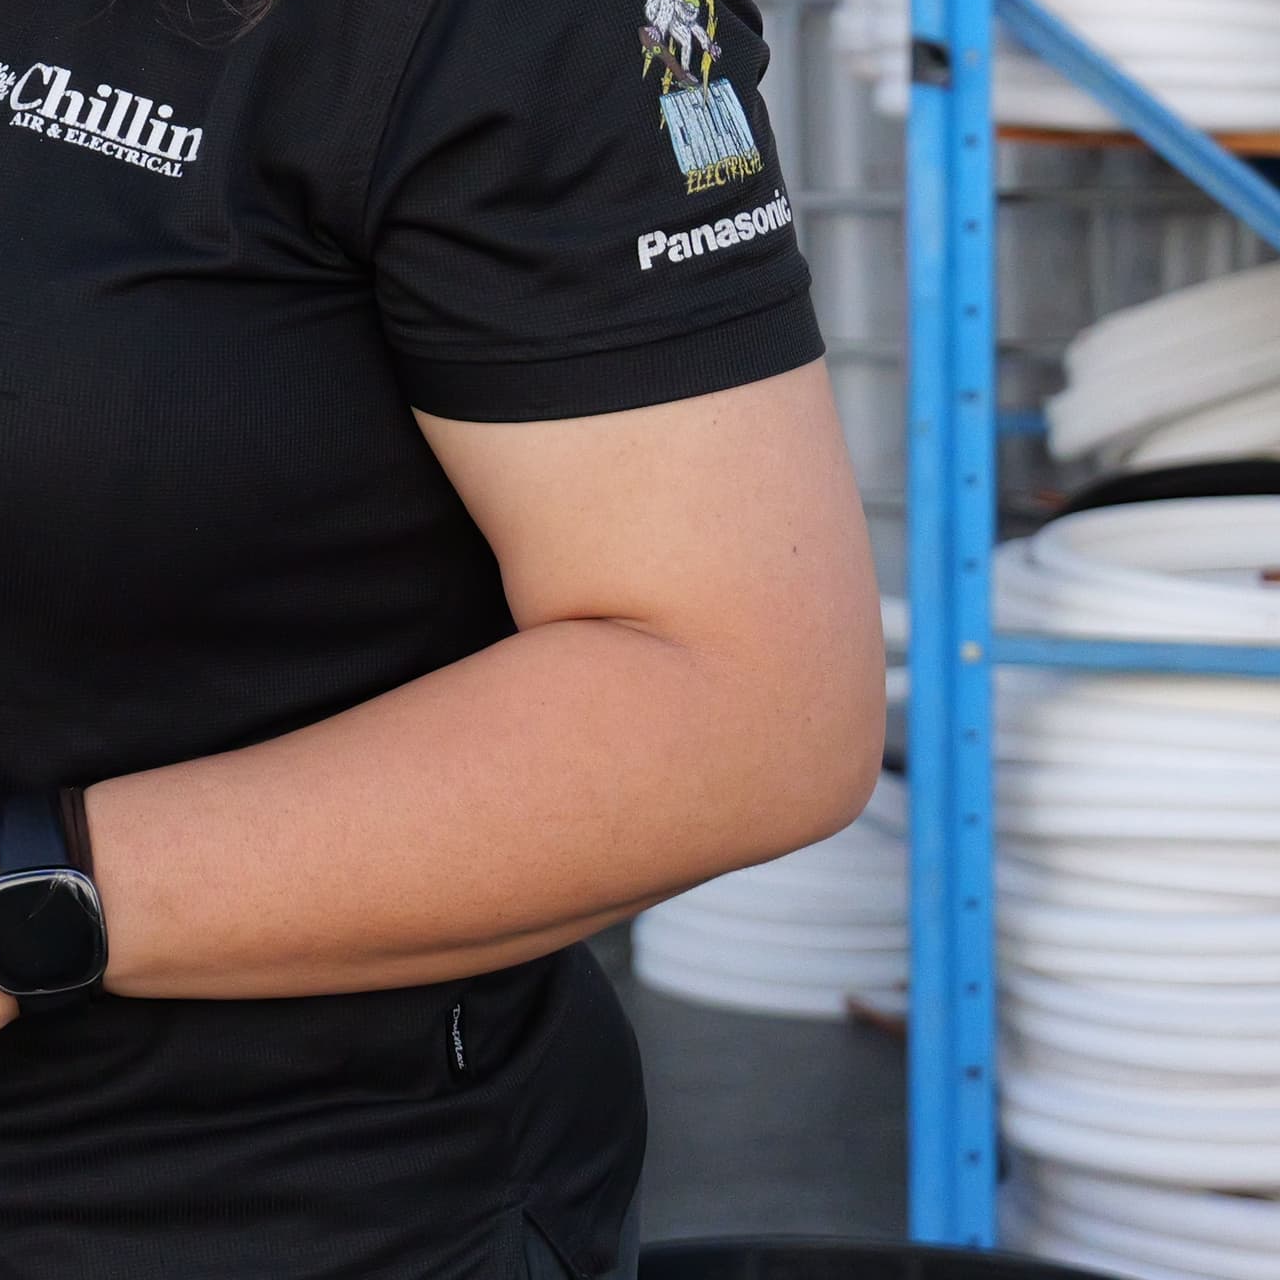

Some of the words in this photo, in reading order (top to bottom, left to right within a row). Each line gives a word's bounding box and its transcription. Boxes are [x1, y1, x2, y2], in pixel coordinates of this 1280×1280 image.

[9, 62, 204, 162] Chillin
[9, 111, 45, 133] AIR
[46, 123, 62, 139] &
[63, 128, 183, 178] ELECTRICAL
[638, 189, 792, 270] Panasonic
